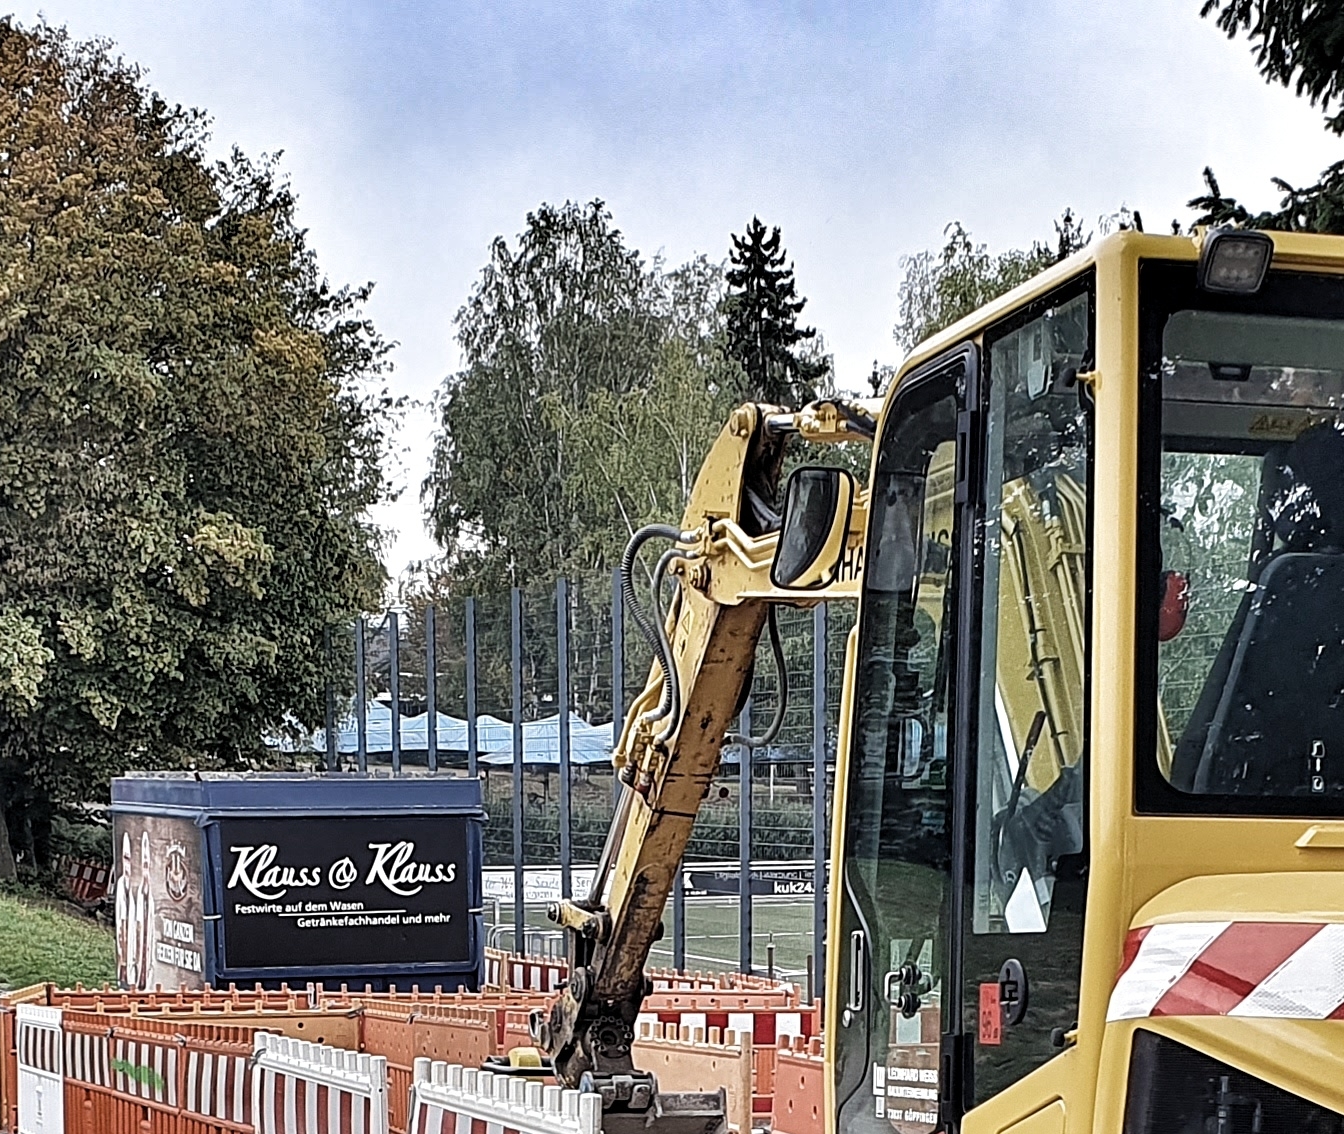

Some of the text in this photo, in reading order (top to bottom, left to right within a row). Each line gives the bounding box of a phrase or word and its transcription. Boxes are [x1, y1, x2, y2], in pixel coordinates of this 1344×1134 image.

[227, 841, 456, 900] Klauss & Klauss
[235, 901, 364, 914] Festwirte auf dem Wasen
[297, 914, 451, 928] Getränkefachhandel und mehr
